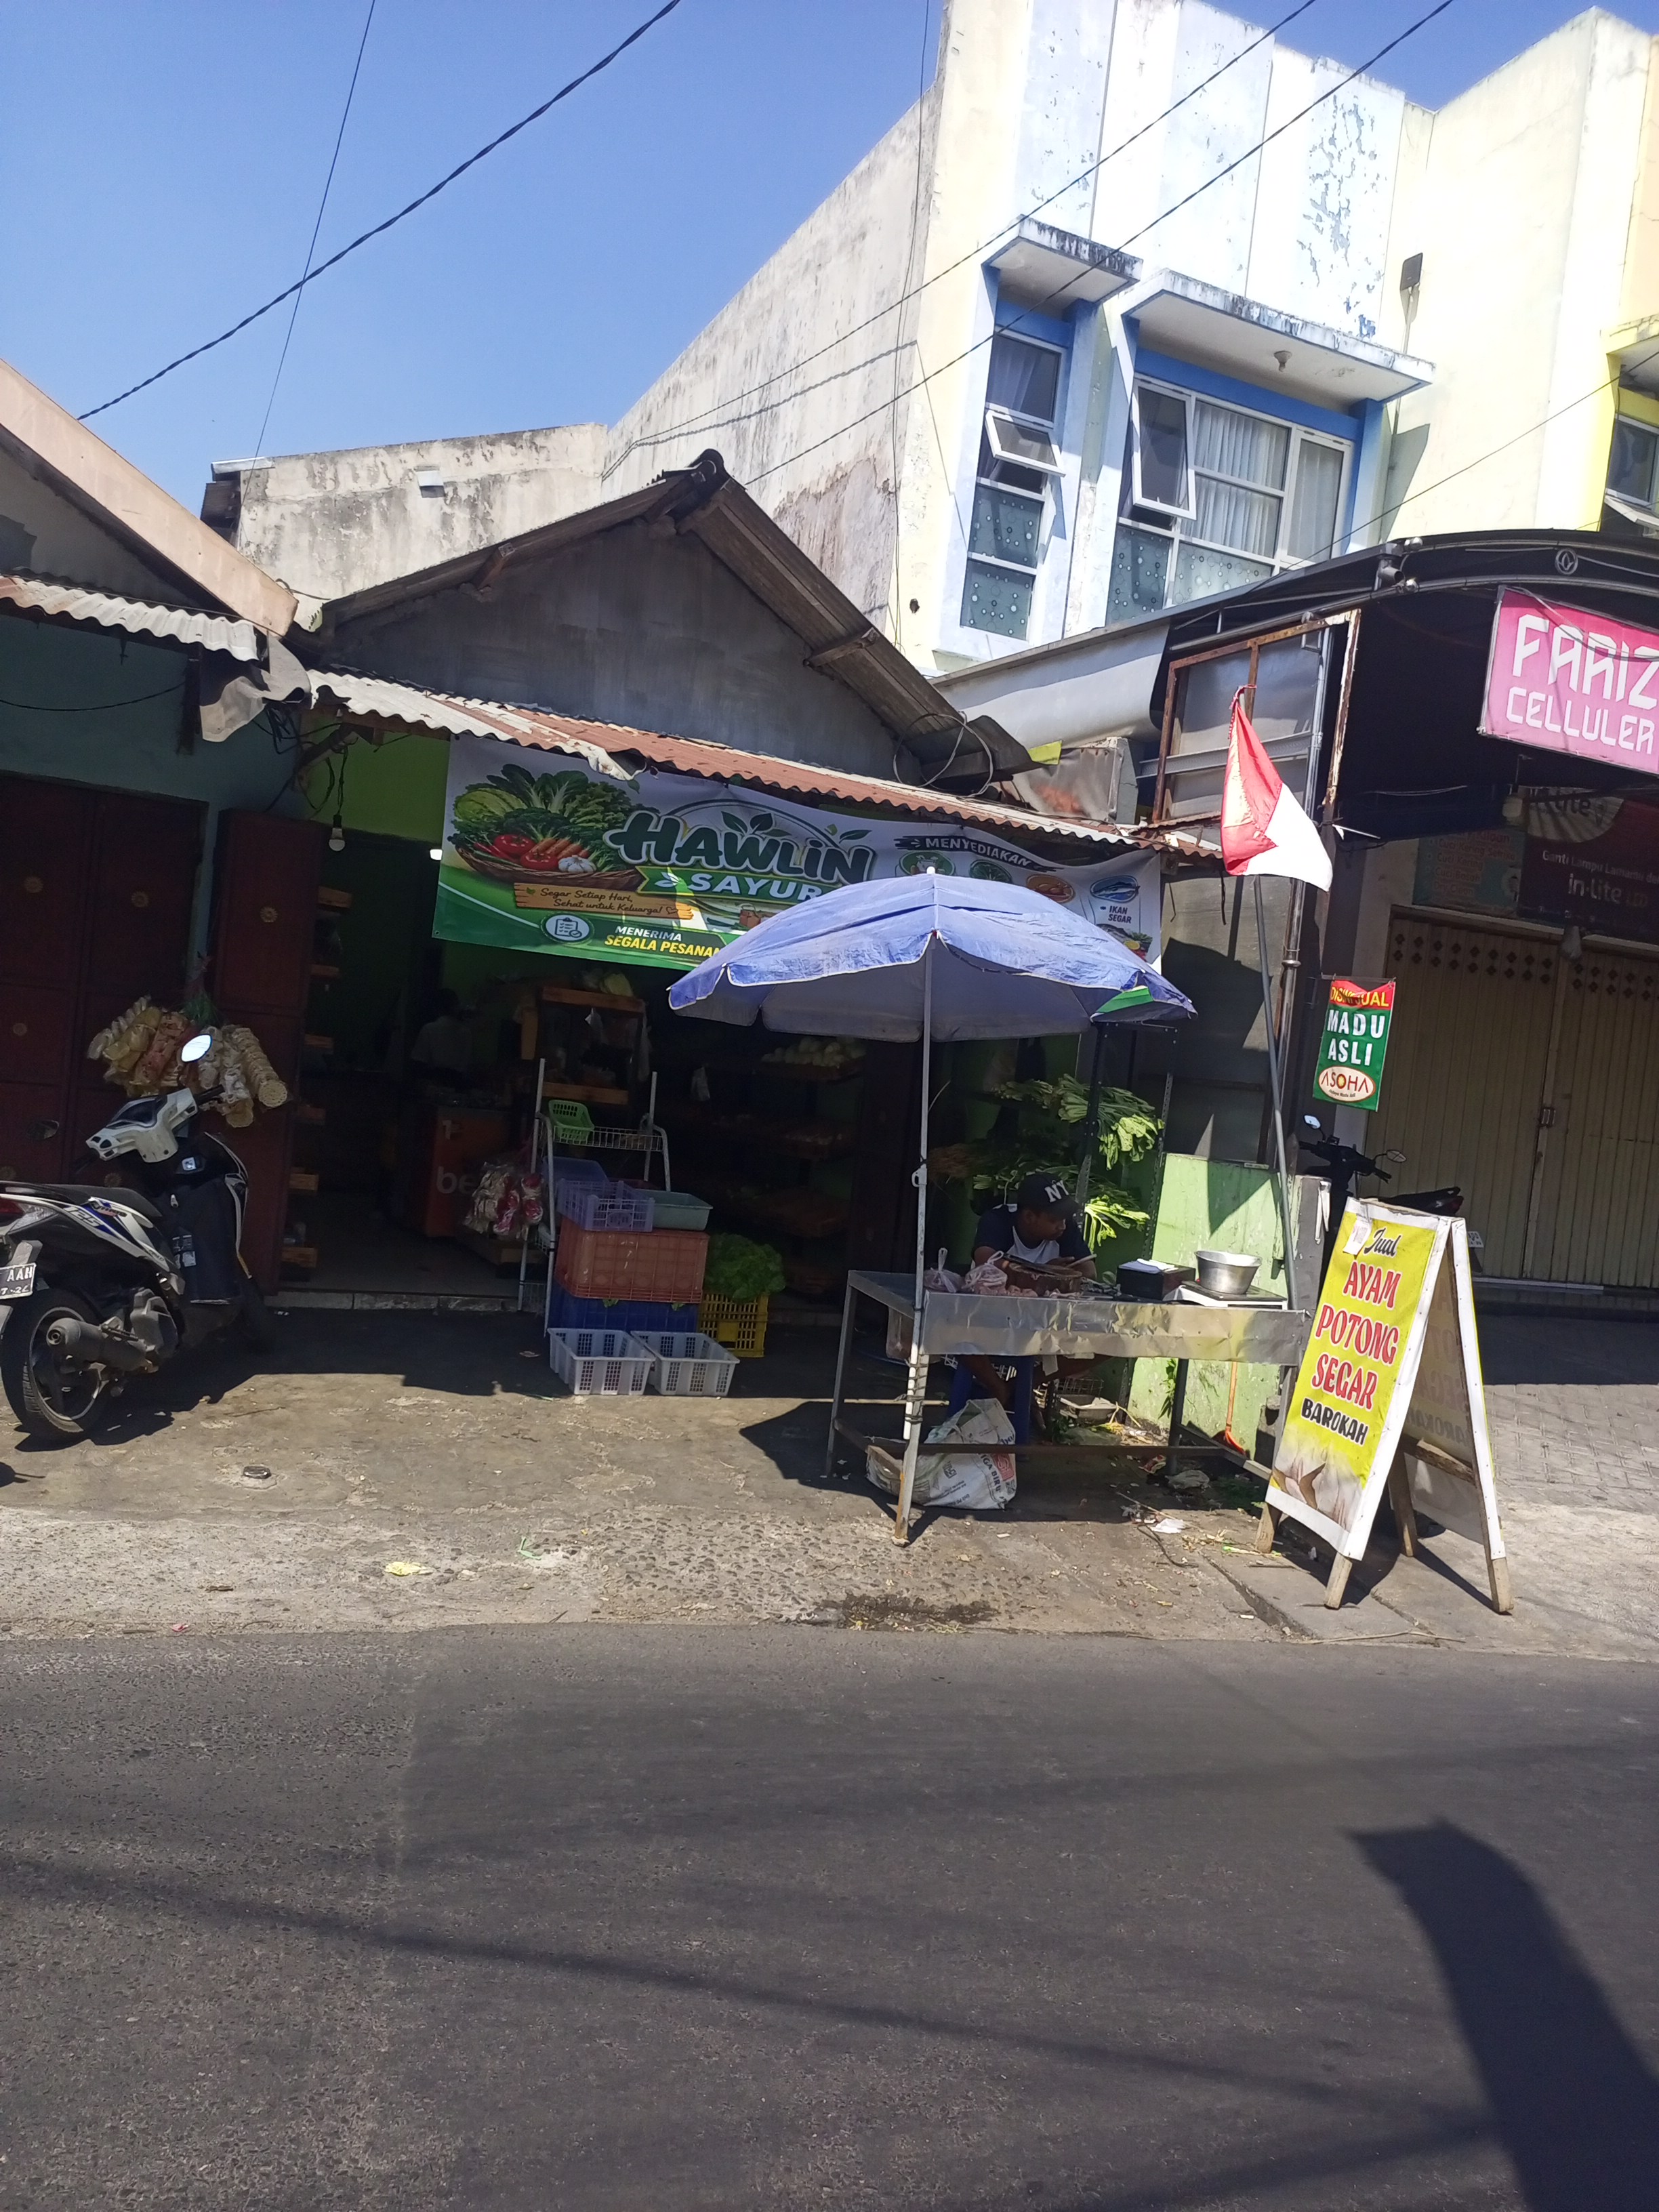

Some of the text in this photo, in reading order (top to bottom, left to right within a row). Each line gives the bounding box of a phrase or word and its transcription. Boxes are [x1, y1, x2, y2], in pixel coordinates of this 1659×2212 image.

[1512, 613, 1659, 710] FARIZ
[1506, 686, 1655, 755] CELLULER
[925, 838, 1032, 867] MENYEDIAKAN
[540, 888, 633, 903] Segar Setiap Hari,
[688, 873, 823, 901] SAYUR
[553, 899, 583, 907] Sehat
[586, 901, 615, 911] untuk
[1108, 914, 1132, 924] SEGAR
[1109, 905, 1128, 915] IKAN
[605, 934, 657, 951] SEGALA
[615, 925, 682, 941] MENERIMA
[1326, 1009, 1385, 1039] MADU
[1328, 1038, 1372, 1066] ASLI
[1321, 1070, 1369, 1094] ASOHA
[1044, 1180, 1069, 1203] NY
[1364, 1227, 1401, 1256] Jual
[1344, 1261, 1401, 1309] AYAM
[1315, 1305, 1399, 1365] POTONG
[1312, 1353, 1378, 1410] SEGAR
[1301, 1397, 1369, 1446] BAROKAH
